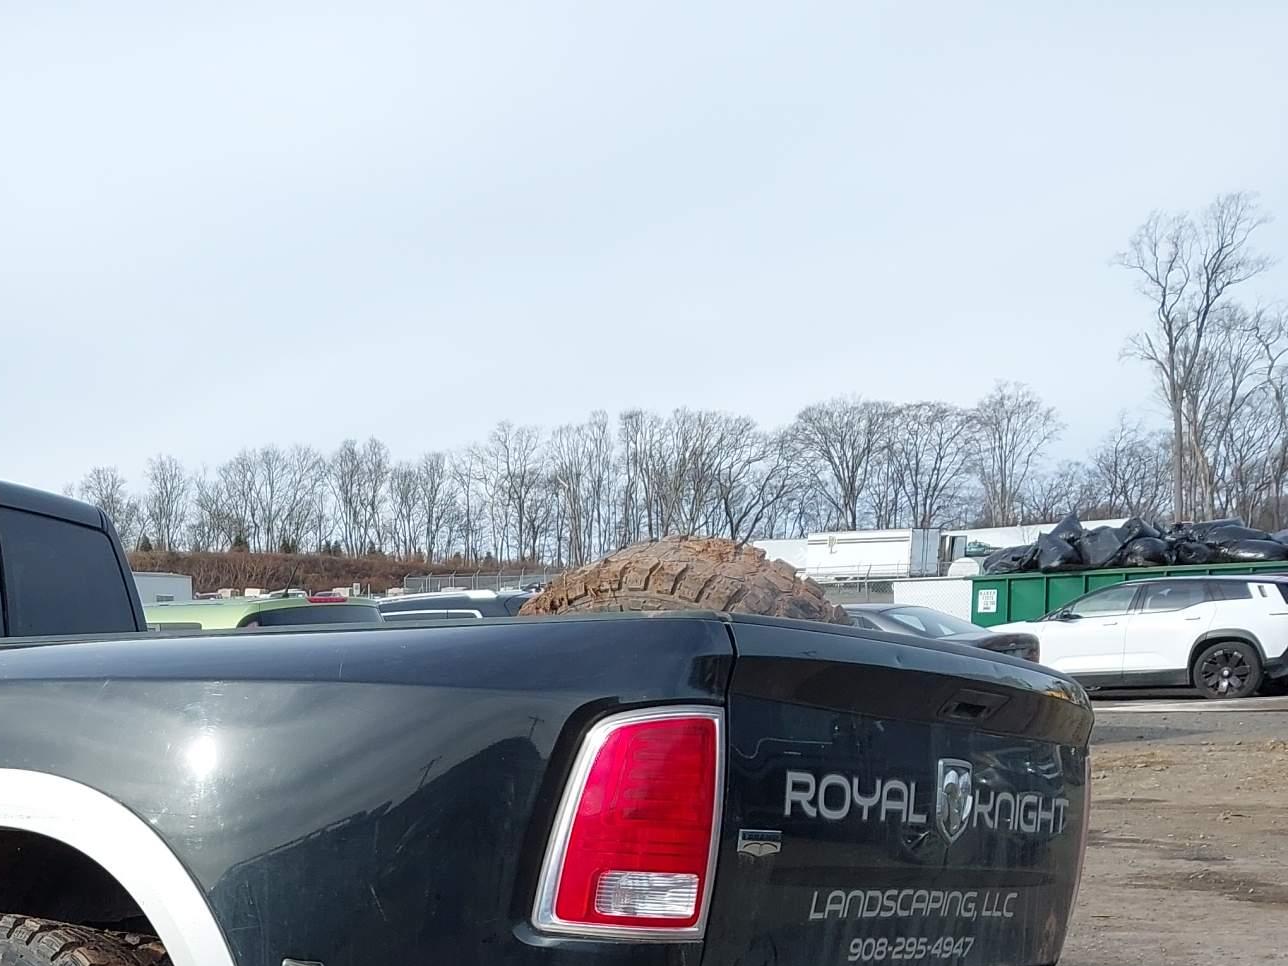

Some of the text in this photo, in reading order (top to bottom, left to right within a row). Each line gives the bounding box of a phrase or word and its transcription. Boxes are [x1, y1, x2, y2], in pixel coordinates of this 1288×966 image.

[784, 770, 1069, 834] ROYAL KNIGHT
[809, 889, 1018, 921] LANDSCAPING, LLC
[848, 937, 974, 961] 908-295-4947
